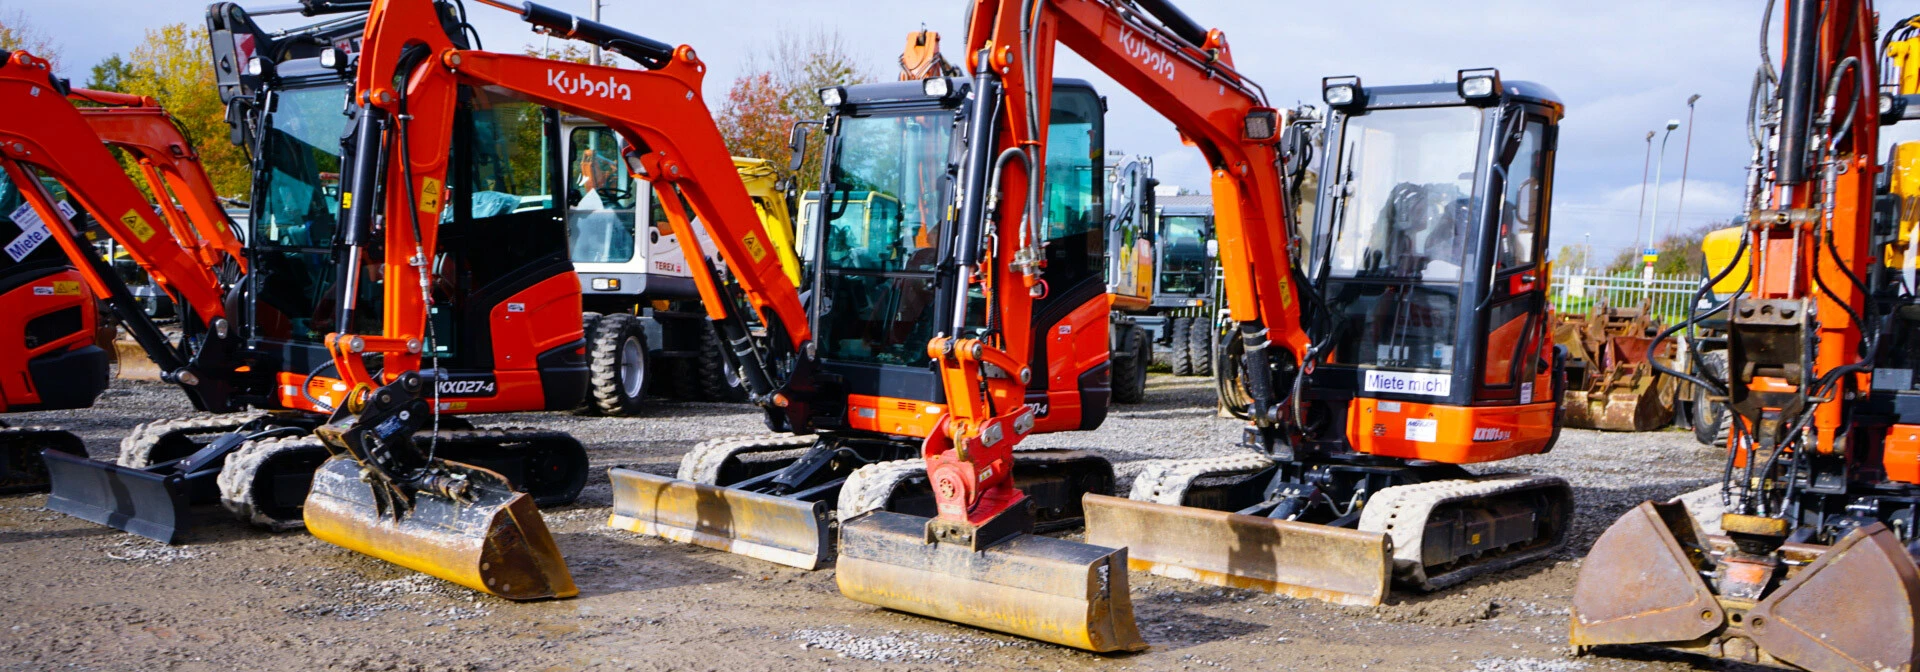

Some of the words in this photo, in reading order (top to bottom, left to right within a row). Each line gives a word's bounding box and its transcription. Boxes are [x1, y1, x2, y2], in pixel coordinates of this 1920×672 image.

[1119, 24, 1175, 81] Kubota
[547, 69, 631, 101] Kubota
[8, 231, 44, 259] Miete
[655, 261, 675, 272] TEREX
[1367, 374, 1405, 390] Miete
[1408, 378, 1449, 393] mich!
